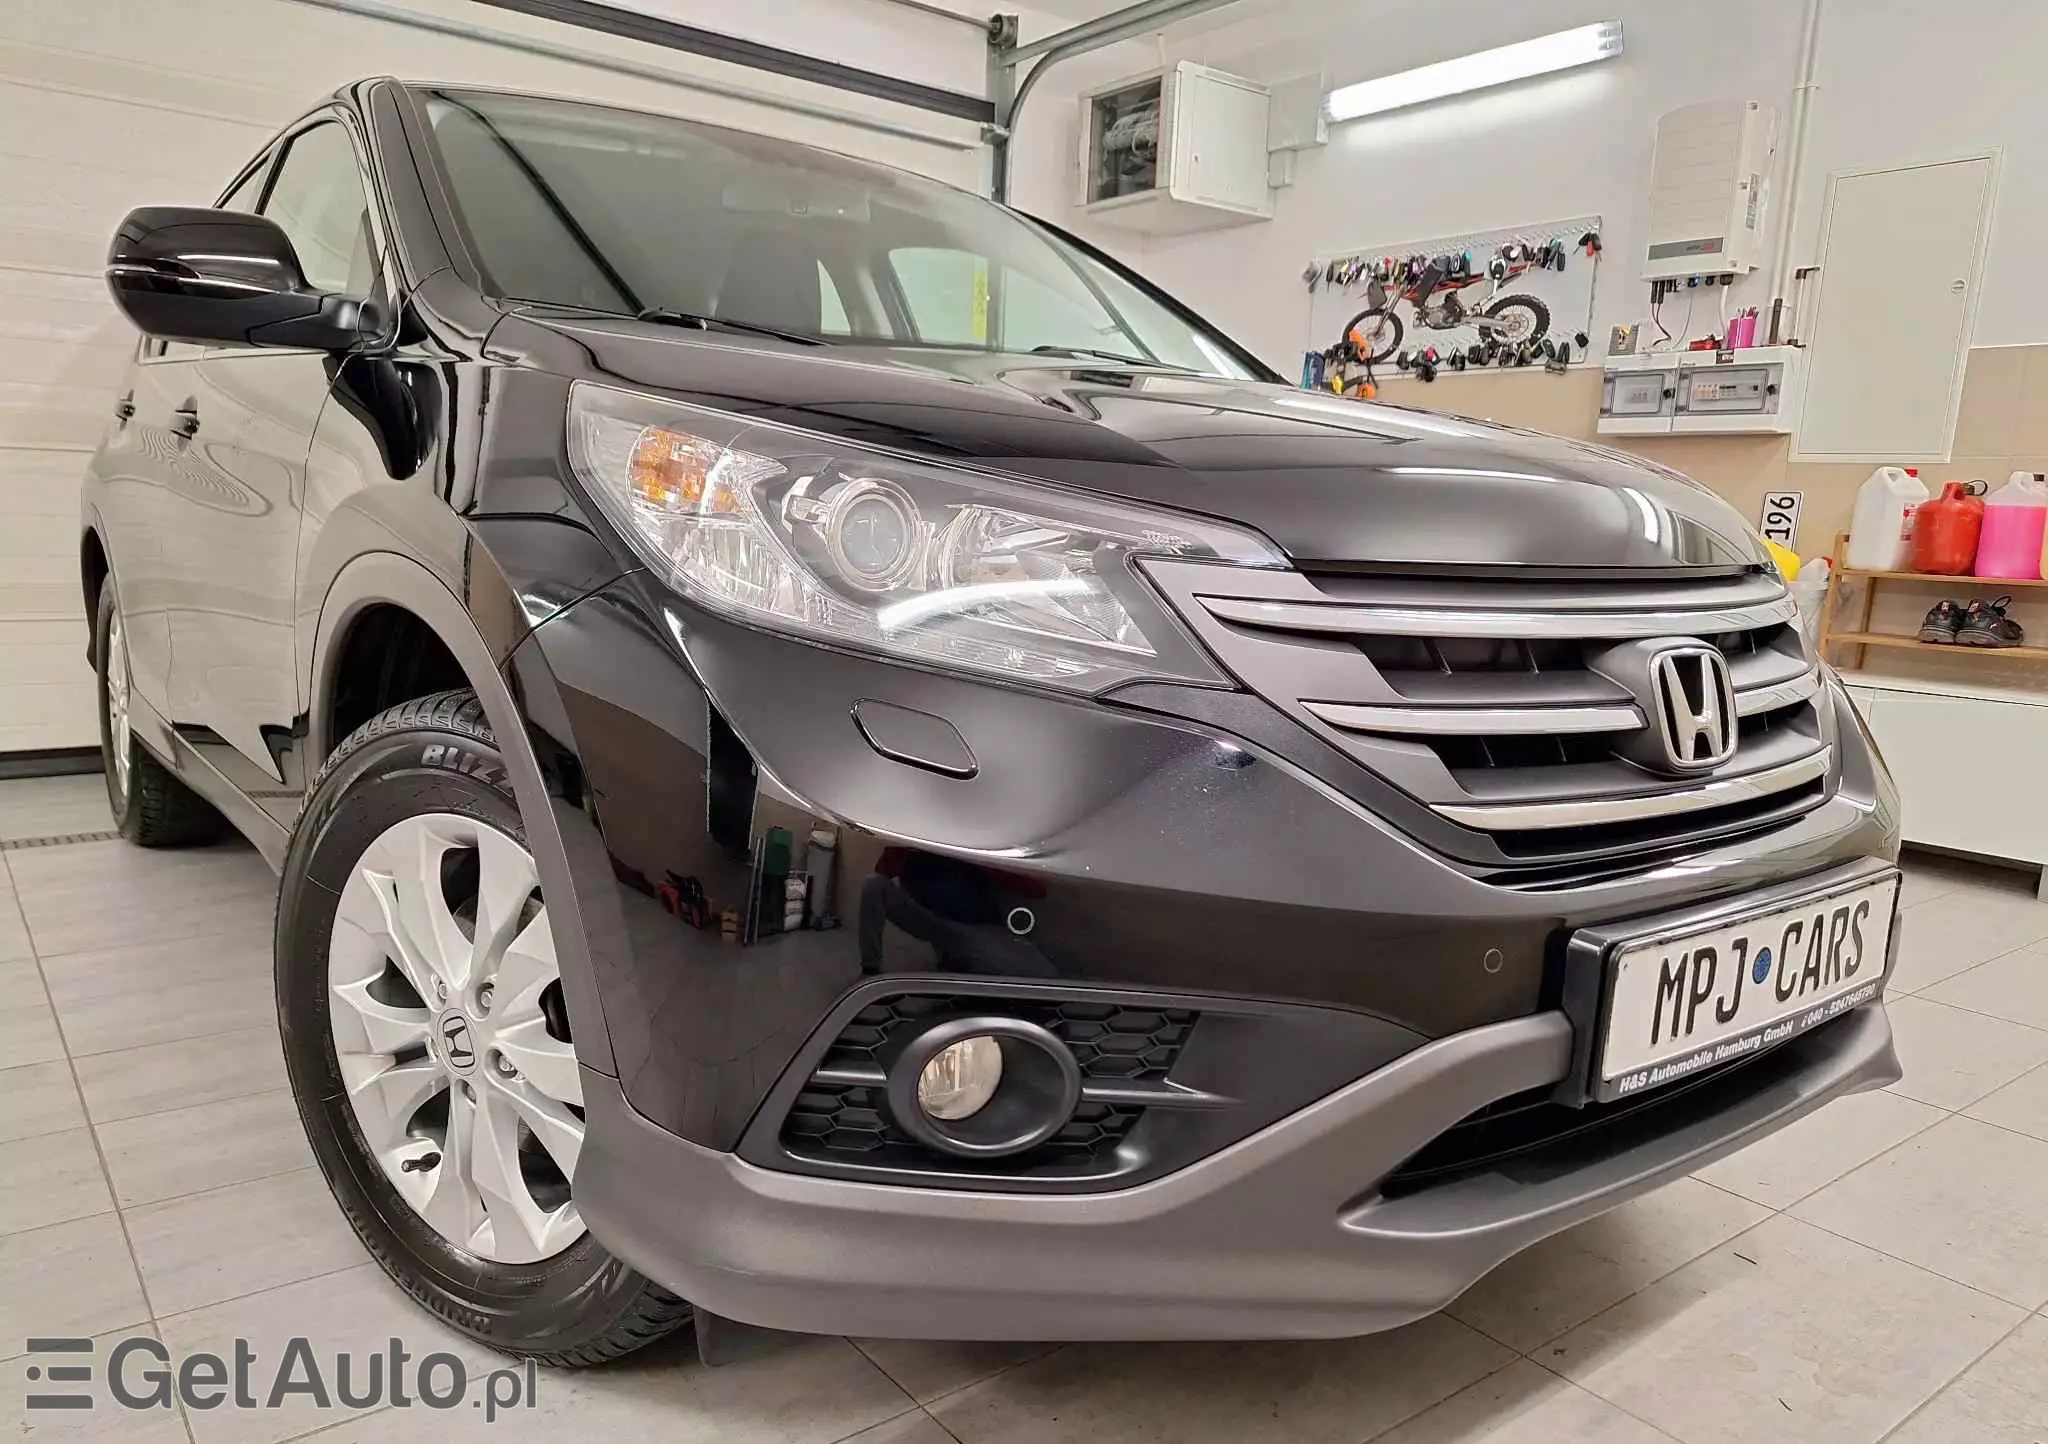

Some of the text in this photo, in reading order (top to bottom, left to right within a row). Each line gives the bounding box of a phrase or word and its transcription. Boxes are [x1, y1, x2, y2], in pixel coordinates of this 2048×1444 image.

[1765, 497, 1794, 540] 196
[1652, 899, 1870, 1045] MPJ CARS
[1619, 1071, 1648, 1093] H&S
[1649, 1050, 1712, 1083] Automobile
[1715, 1034, 1761, 1061] Hamburg
[1763, 1020, 1793, 1042] GmbH
